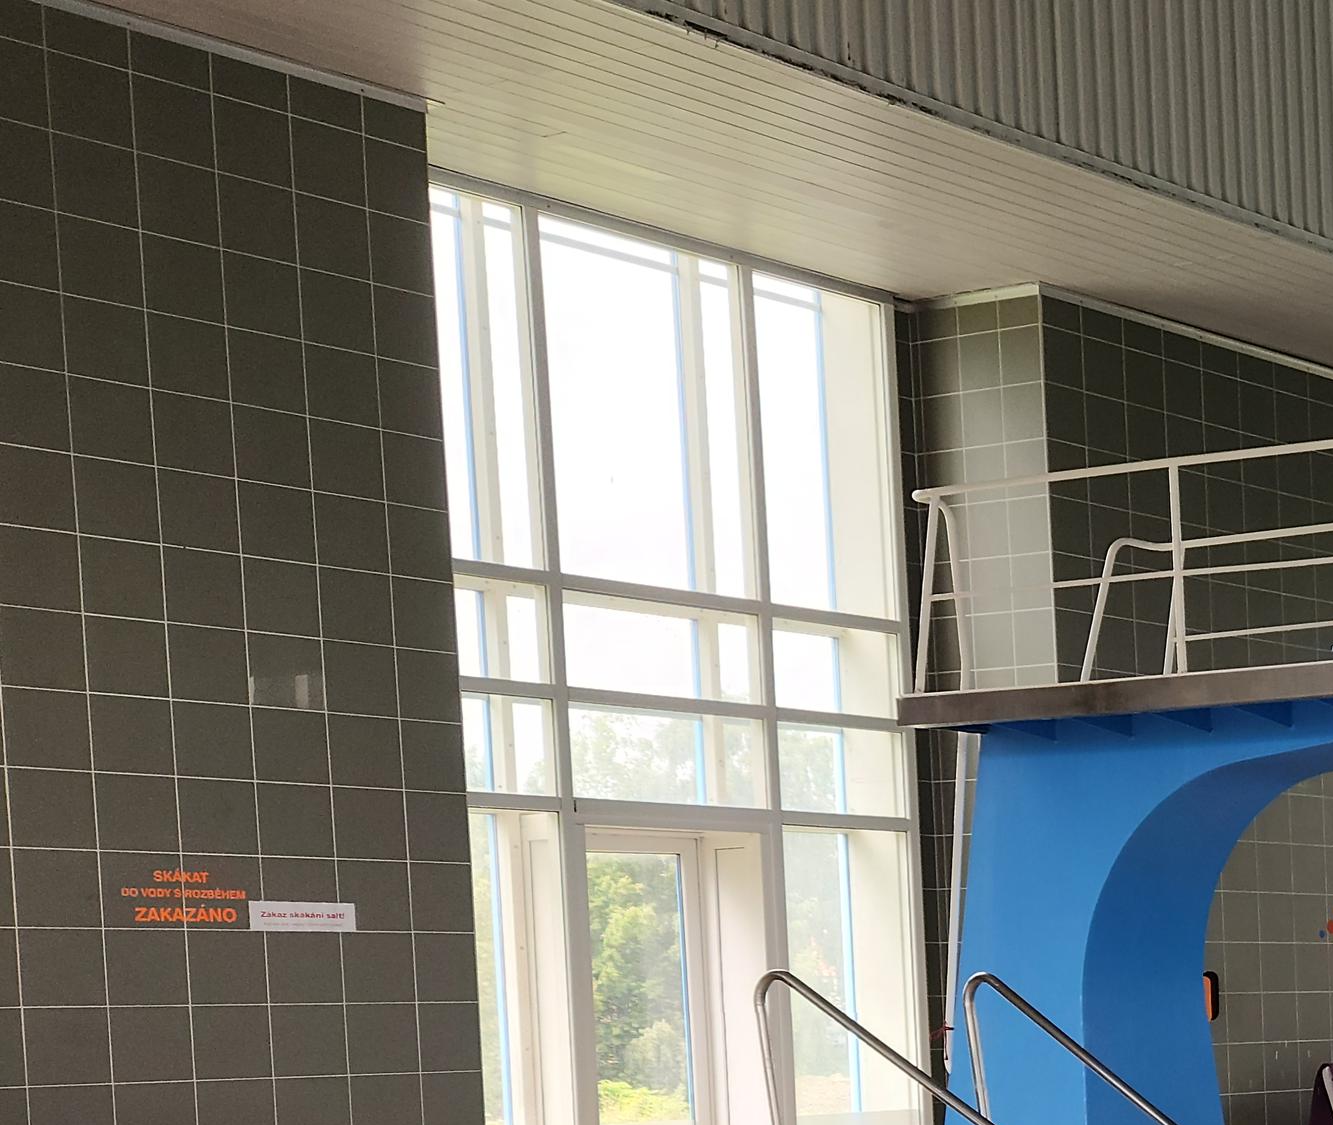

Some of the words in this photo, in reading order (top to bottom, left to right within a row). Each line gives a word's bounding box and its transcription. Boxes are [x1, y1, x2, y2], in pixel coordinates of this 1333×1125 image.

[152, 868, 209, 882] SKÁKAT
[121, 887, 138, 897] DO
[141, 887, 171, 898] VODY
